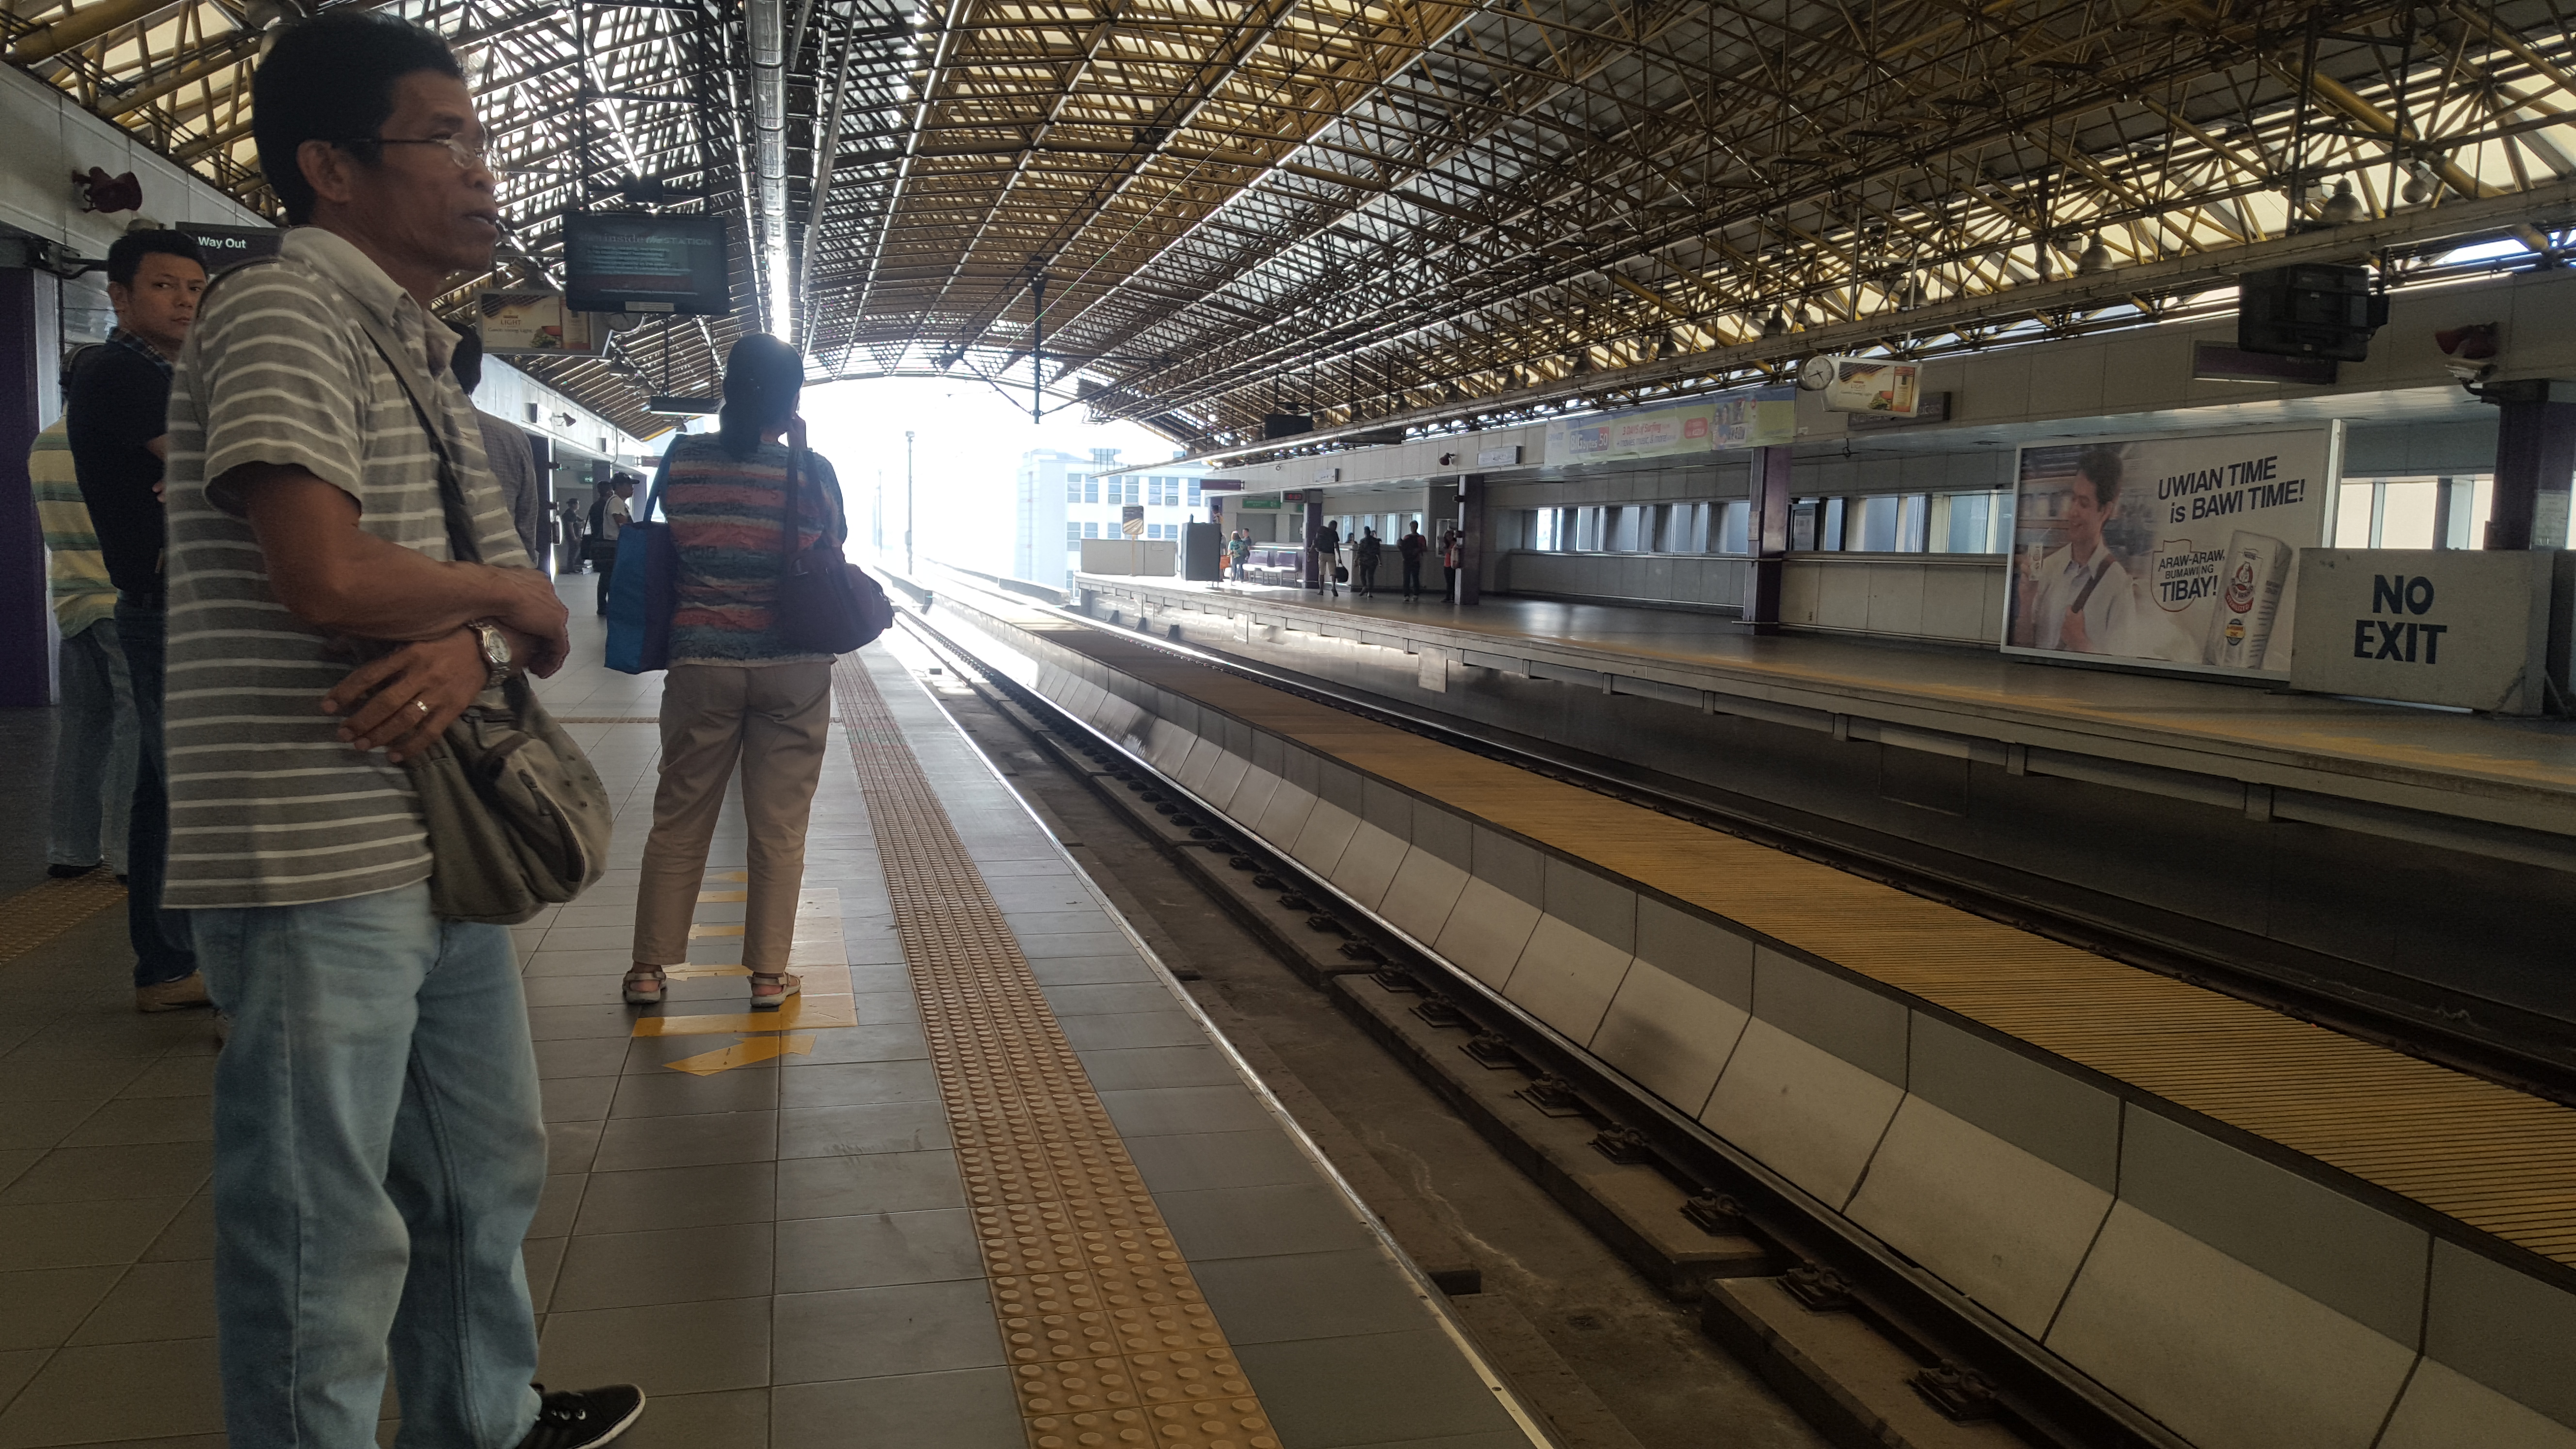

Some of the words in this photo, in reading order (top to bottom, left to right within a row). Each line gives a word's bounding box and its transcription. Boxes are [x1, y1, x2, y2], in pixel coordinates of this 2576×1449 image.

[198, 236, 223, 249] Way
[225, 238, 246, 249] Out
[662, 237, 712, 245] STATION
[1599, 433, 1608, 446] 50
[2158, 467, 2224, 500] UWIAN
[2228, 455, 2278, 486] TIME
[2170, 502, 2186, 524] is
[2192, 489, 2243, 520] BAWI
[2247, 478, 2305, 510] TIME!
[2158, 549, 2225, 572] ARAW-ARAW,
[2165, 566, 2199, 580] BUMAWI
[2201, 564, 2214, 575] NG
[2160, 575, 2218, 602] TIBAY!
[2372, 574, 2435, 615] NO
[2354, 619, 2447, 664] EXIT
